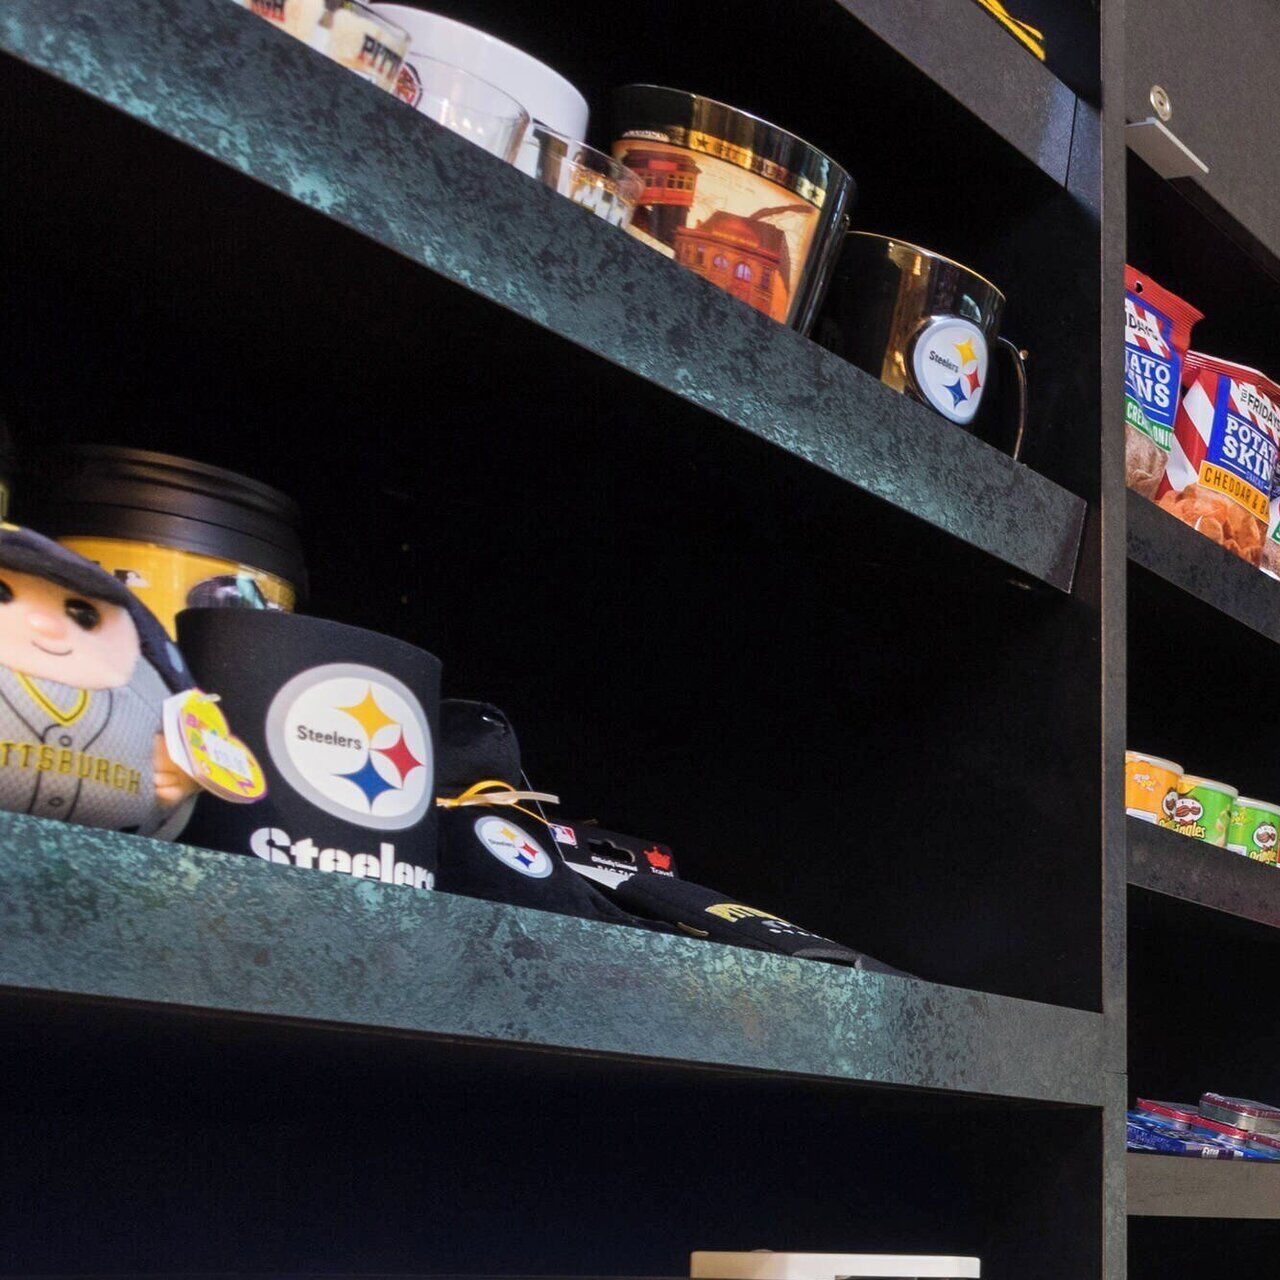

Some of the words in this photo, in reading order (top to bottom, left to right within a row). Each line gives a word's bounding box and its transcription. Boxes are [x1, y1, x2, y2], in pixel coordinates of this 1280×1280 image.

[929, 350, 960, 373] Steelers
[1247, 392, 1280, 433] FRIDAYS
[1203, 466, 1252, 501] CHEDDAR
[296, 723, 363, 752] Steelers
